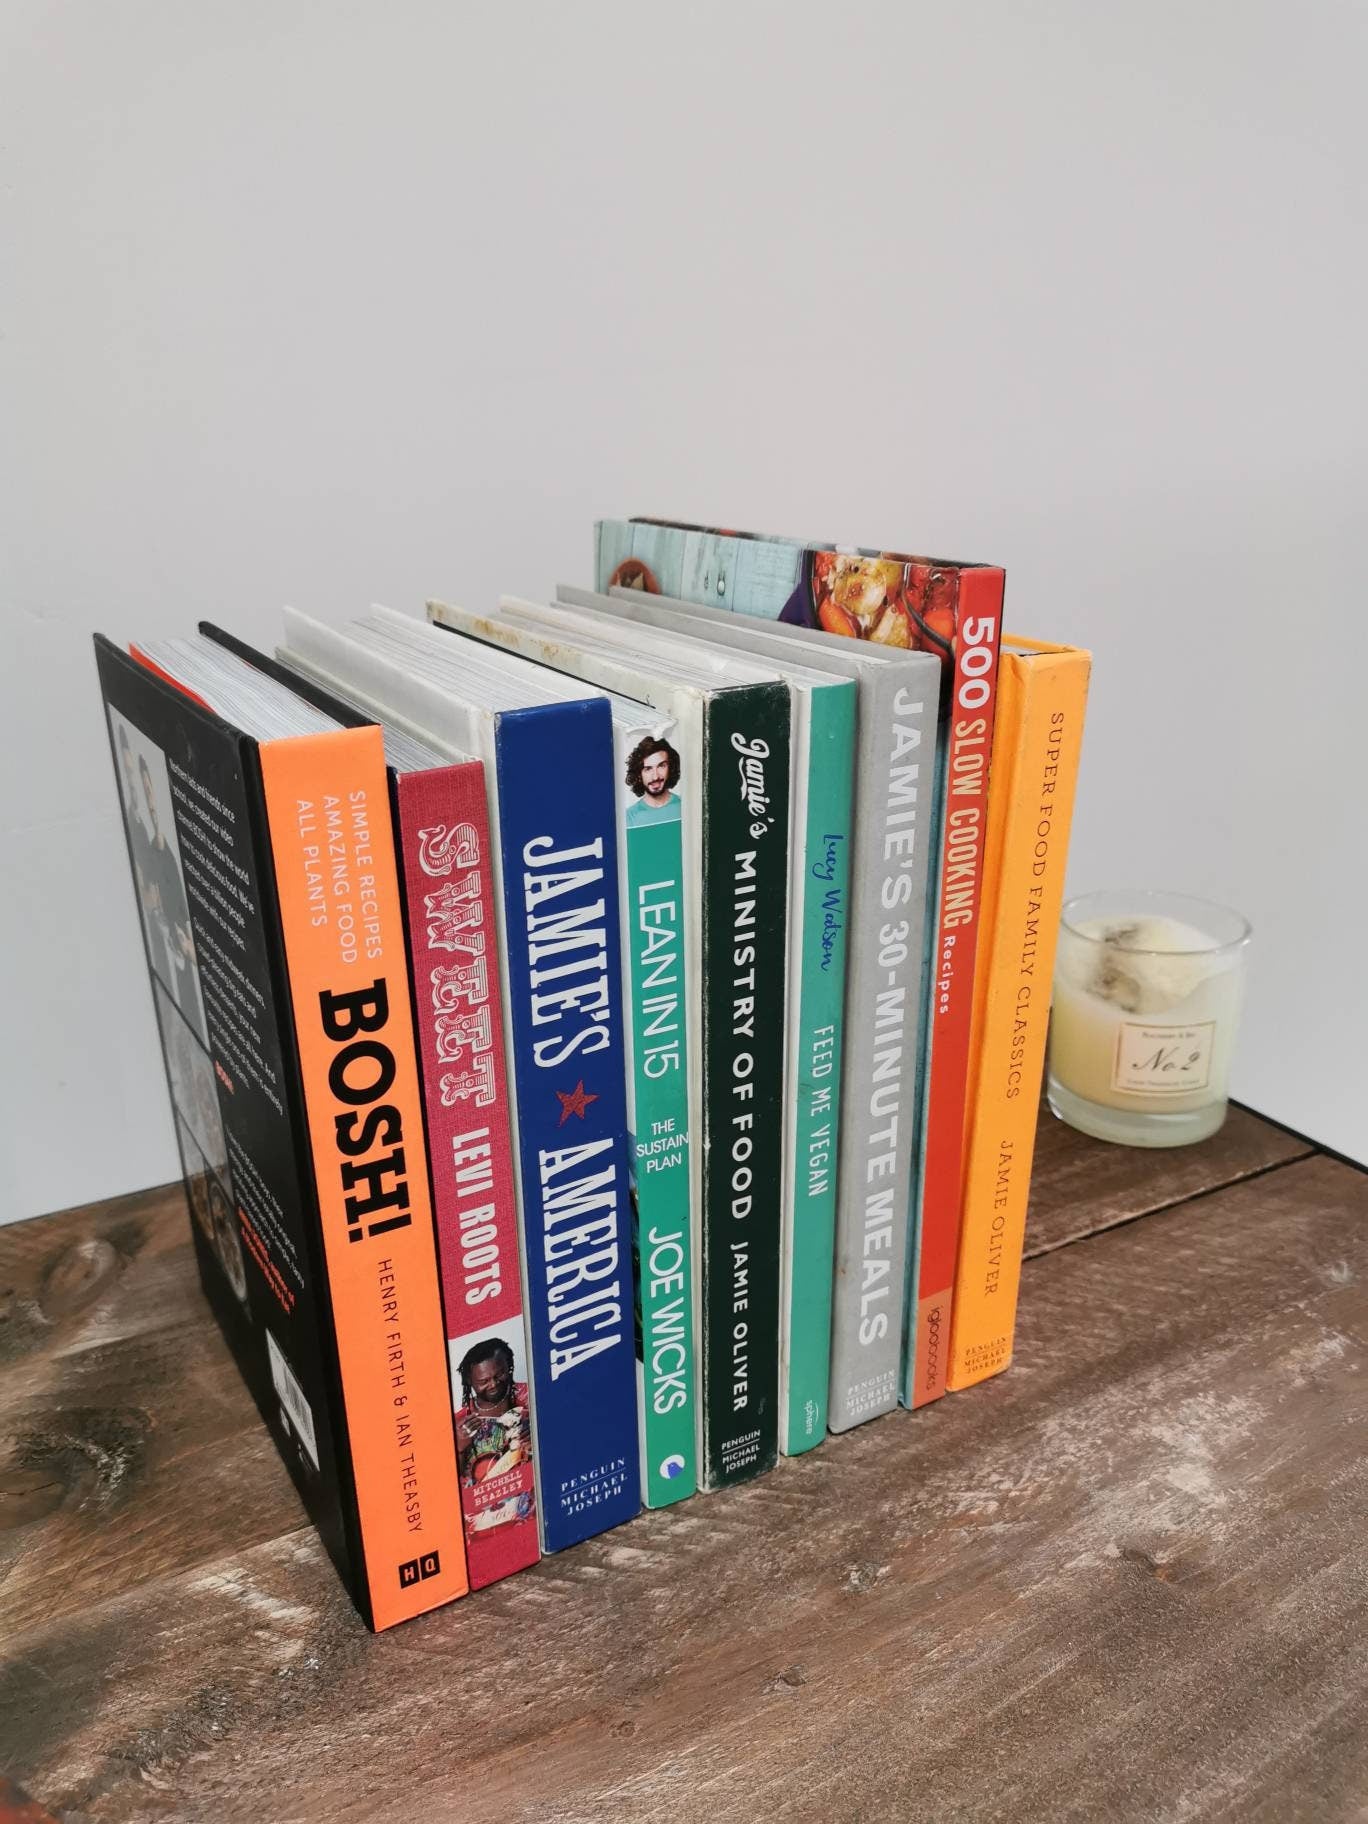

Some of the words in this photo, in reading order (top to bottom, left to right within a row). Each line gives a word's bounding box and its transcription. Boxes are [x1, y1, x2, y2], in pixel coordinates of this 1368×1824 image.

[957, 616, 995, 710] 500
[730, 732, 776, 840] Jamie's
[951, 718, 987, 797] SLOW
[1041, 711, 1065, 797] SUPER
[296, 799, 317, 839] ALL
[349, 790, 373, 867] SIMPLE
[881, 687, 923, 910] JAMIE'S
[323, 795, 350, 897] AMAZING
[812, 833, 843, 882] Lucy
[942, 806, 981, 930] COOKING
[1031, 803, 1053, 878] FOOD
[303, 845, 328, 927] PLANTS
[359, 874, 383, 959] RECIPES
[336, 903, 358, 964] FOOD
[417, 822, 497, 1108] SWEET
[522, 835, 611, 1068] JAMIE'S
[638, 879, 677, 989] LEAN
[732, 850, 757, 1040] MINISTRY
[819, 888, 846, 972] Watson
[1018, 886, 1043, 978] FAMILY
[935, 936, 956, 1015] Recipes
[641, 992, 679, 1038] IN
[867, 920, 910, 1184] 30-MINUTE
[1006, 986, 1031, 1100] CLASSICS
[642, 1039, 680, 1079] 15
[732, 1051, 754, 1101] OF
[810, 1025, 835, 1080] FEED
[319, 977, 412, 1244] BOSH!
[651, 1118, 675, 1136] THE
[809, 1086, 832, 1118] ME
[452, 1126, 494, 1198] LEVI
[636, 1131, 689, 1157] SUSTAIN
[646, 1152, 682, 1174] PLAN
[731, 1113, 754, 1220] FOOD
[808, 1123, 832, 1198] VEGAN
[992, 1139, 1013, 1210] JAMIE
[377, 1257, 399, 1323] HENRY
[458, 1201, 503, 1306] ROOTS
[538, 1136, 622, 1382] AMERICA
[648, 1225, 685, 1298] JOE
[730, 1241, 749, 1314] JAMIE
[858, 1187, 895, 1346] MEALS
[984, 1216, 1006, 1297] OLIVER
[385, 1331, 406, 1389] FIRTH
[649, 1297, 688, 1416] WICKS
[733, 1322, 749, 1413] OLIVER
[847, 1368, 896, 1396] PENGUIN
[395, 1413, 413, 1448] IAN
[846, 1382, 896, 1409] MICHAEL
[849, 1393, 891, 1417] JOSEPH
[561, 1457, 625, 1493] PENGUIN
[721, 1429, 761, 1450] PENGUIN
[722, 1443, 761, 1464] MICHAEL
[725, 1453, 757, 1474] JOSEPH
[399, 1452, 425, 1534] THEASBY
[472, 1470, 523, 1497] MITCHELL
[474, 1479, 524, 1506] BEAZLEY
[560, 1472, 628, 1509] MICHAEL
[567, 1485, 622, 1516] JOSEPH
[402, 1554, 438, 1583] HQ
